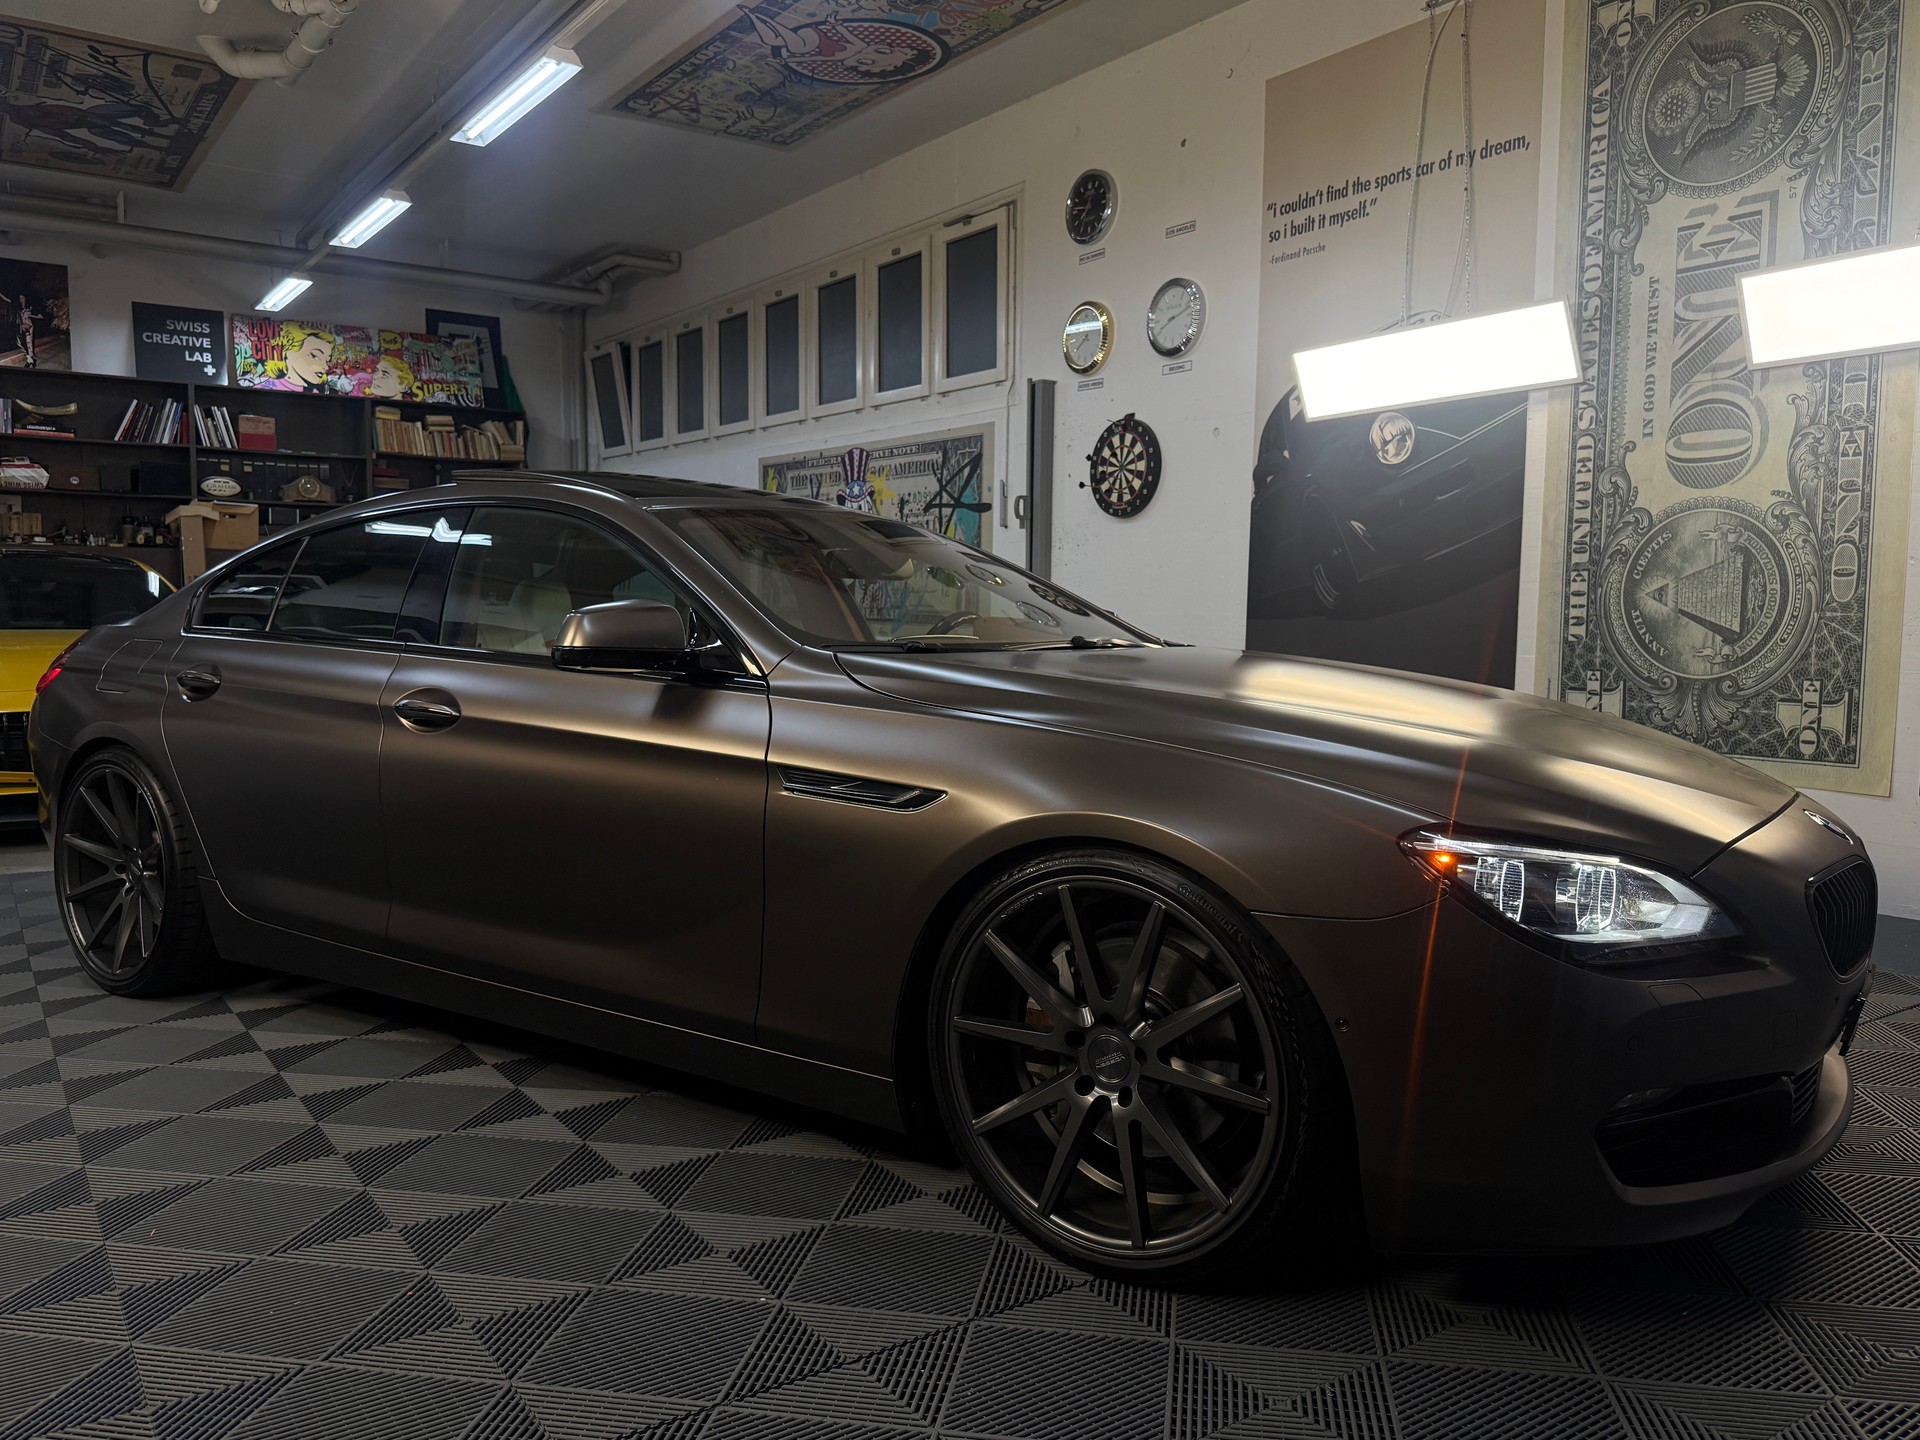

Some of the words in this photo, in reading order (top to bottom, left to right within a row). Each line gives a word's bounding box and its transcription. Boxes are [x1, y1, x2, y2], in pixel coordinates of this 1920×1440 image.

[1821, 44, 1830, 89] UNITED
[1326, 179, 1348, 202] find
[1352, 175, 1371, 196] the
[1374, 166, 1412, 192] sports
[1415, 161, 1435, 178] car
[1438, 149, 1453, 171] of
[1455, 149, 1476, 168] my
[1479, 135, 1531, 161] dream,
[1586, 73, 1612, 238] AMERICA
[1788, 186, 1797, 199] 57
[1268, 229, 1281, 243] so
[1283, 223, 1287, 239] i
[1290, 214, 1315, 237] built
[1318, 213, 1326, 230] it
[1302, 242, 1326, 257] Porsche
[1583, 245, 1604, 293] OF
[1646, 276, 1661, 335] TRUST
[142, 332, 212, 349] CREATIVE
[165, 319, 211, 334] SWISS
[1664, 190, 1780, 490] ONE
[185, 350, 213, 364] LAB
[251, 340, 285, 361] CITY
[1577, 296, 1602, 430] STATES
[1645, 341, 1658, 371] WE
[1643, 373, 1655, 413] GOD
[1642, 418, 1654, 439] IN
[894, 445, 919, 456] NOTE
[1571, 434, 1596, 569] UNITED
[1831, 425, 1867, 602] ONE
[1744, 535, 1777, 585] SECLORUM
[1787, 543, 1801, 575] SEAL
[1568, 569, 1588, 642] THE
[1764, 587, 1778, 620] ORDO
[1793, 576, 1802, 616] GREAT
[1631, 609, 1669, 657] ANNUIT
[1738, 619, 1768, 653] NOVUS
[1781, 617, 1797, 640] THE
[1799, 680, 1821, 756] ONE
